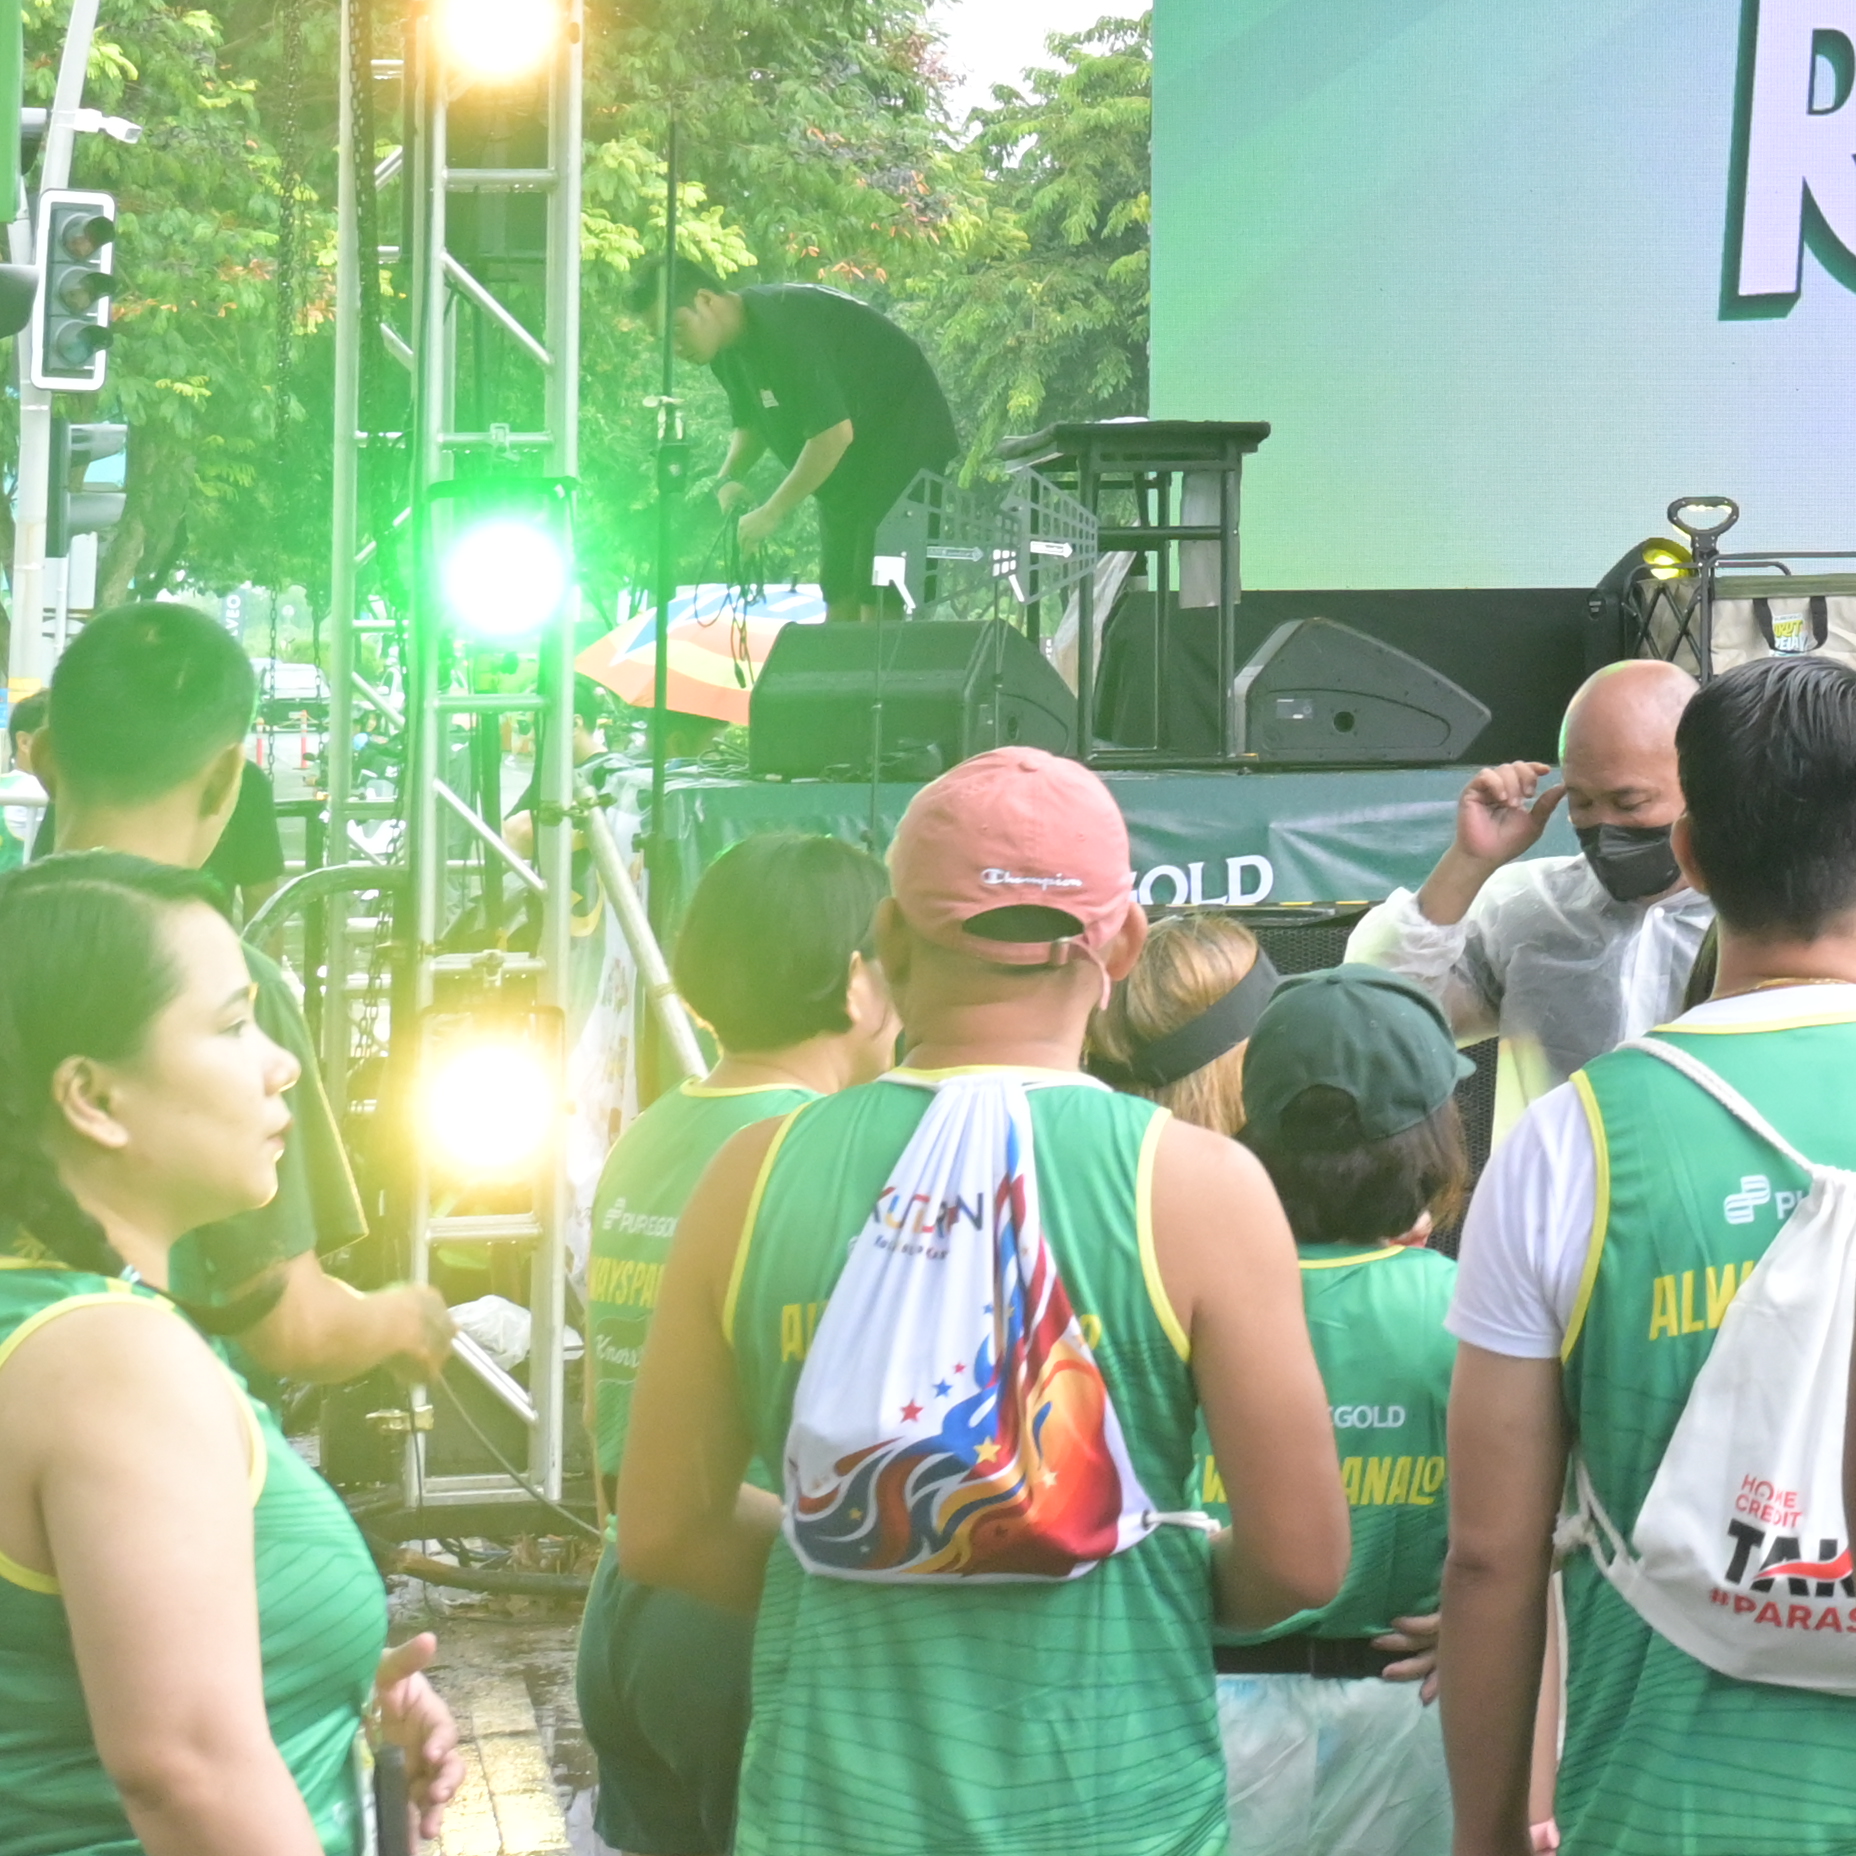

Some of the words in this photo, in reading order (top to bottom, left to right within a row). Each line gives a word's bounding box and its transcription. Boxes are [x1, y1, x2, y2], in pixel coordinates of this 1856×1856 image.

[980, 867, 1084, 891] Champion
[1329, 1405, 1406, 1430] GOLD
[1741, 1473, 1798, 1509] HOME
[1735, 1493, 1802, 1528] CREDIT
